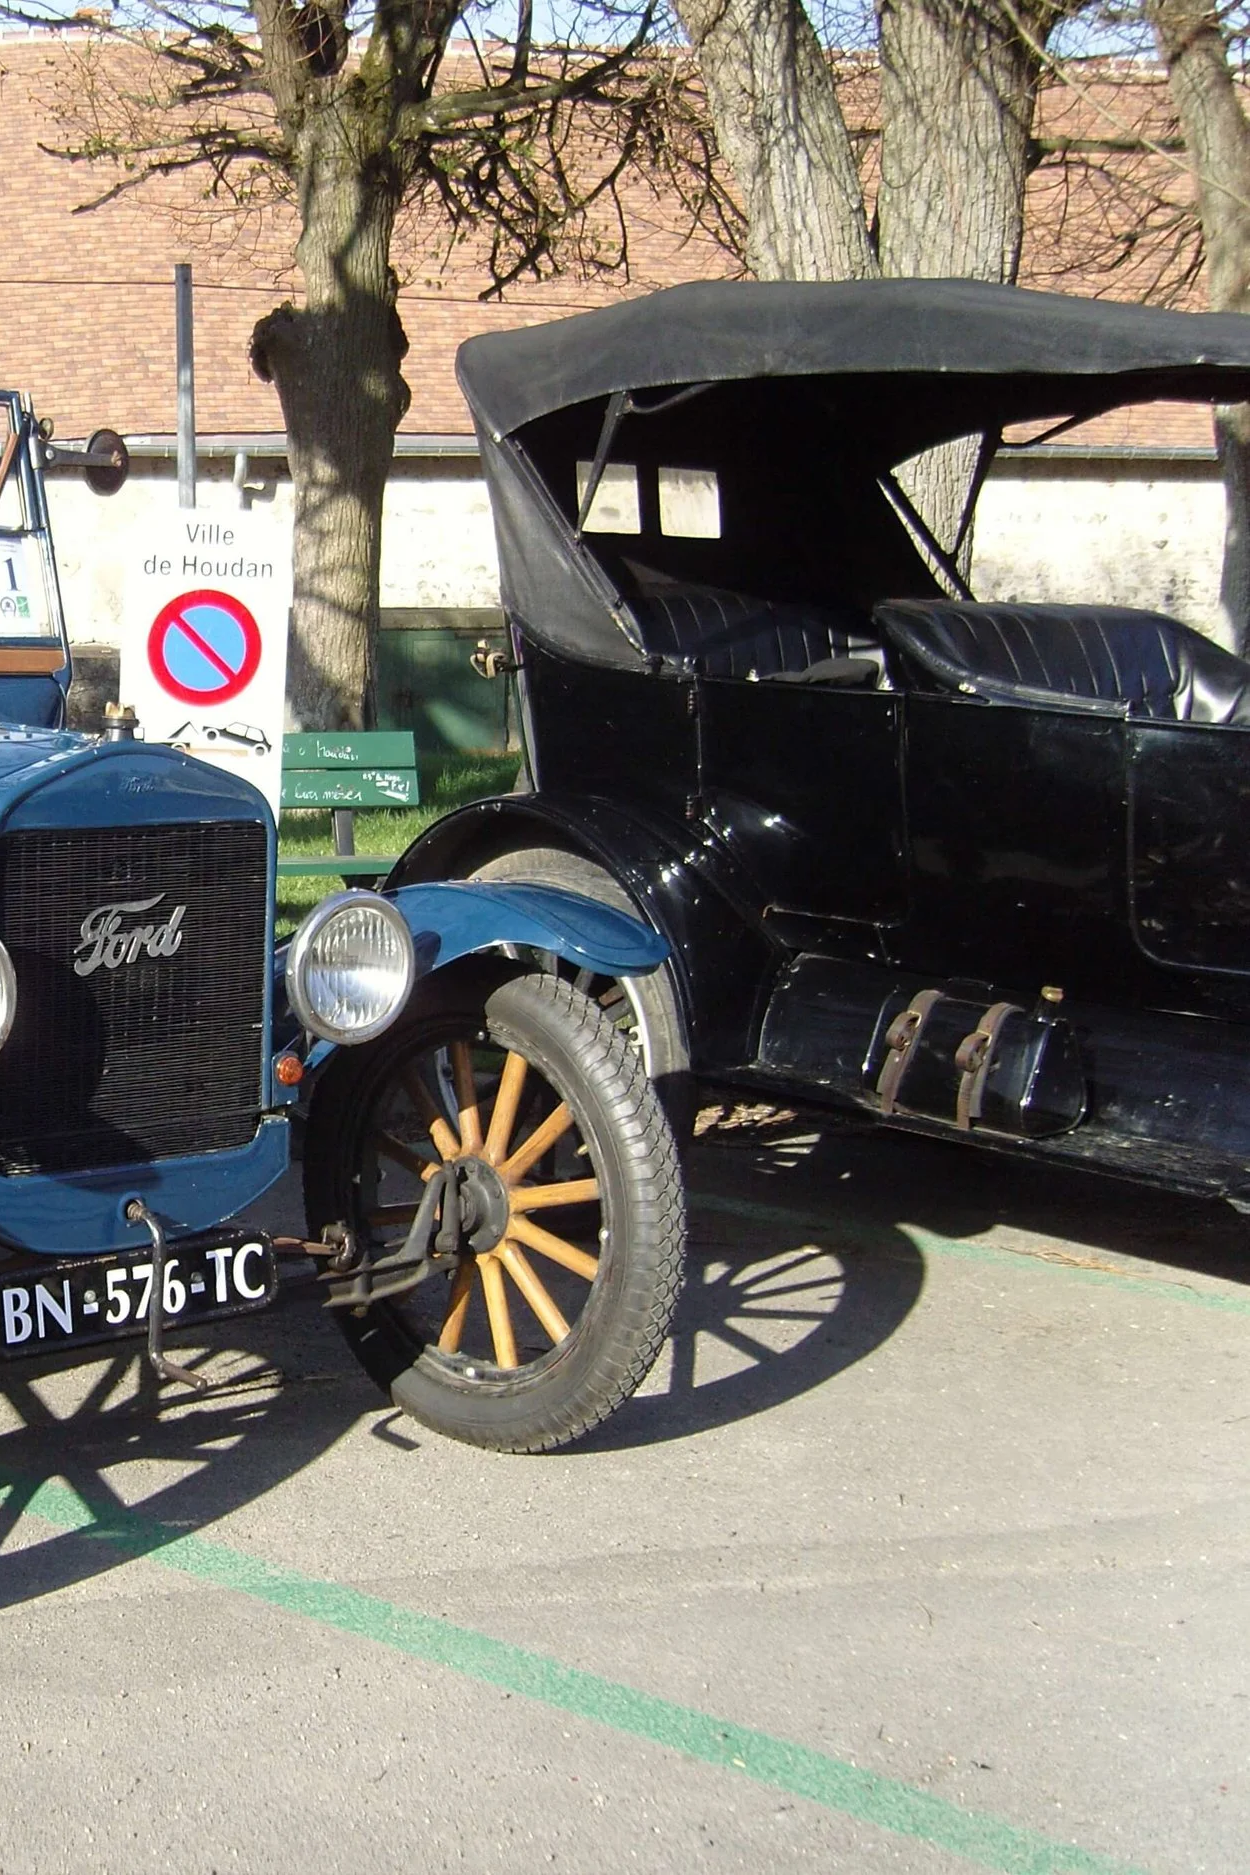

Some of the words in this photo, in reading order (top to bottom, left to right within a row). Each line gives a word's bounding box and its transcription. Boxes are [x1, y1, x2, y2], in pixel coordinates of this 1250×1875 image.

[186, 523, 235, 546] Ville
[143, 555, 172, 576] de
[182, 555, 273, 578] Houdan
[73, 892, 186, 976] Ford
